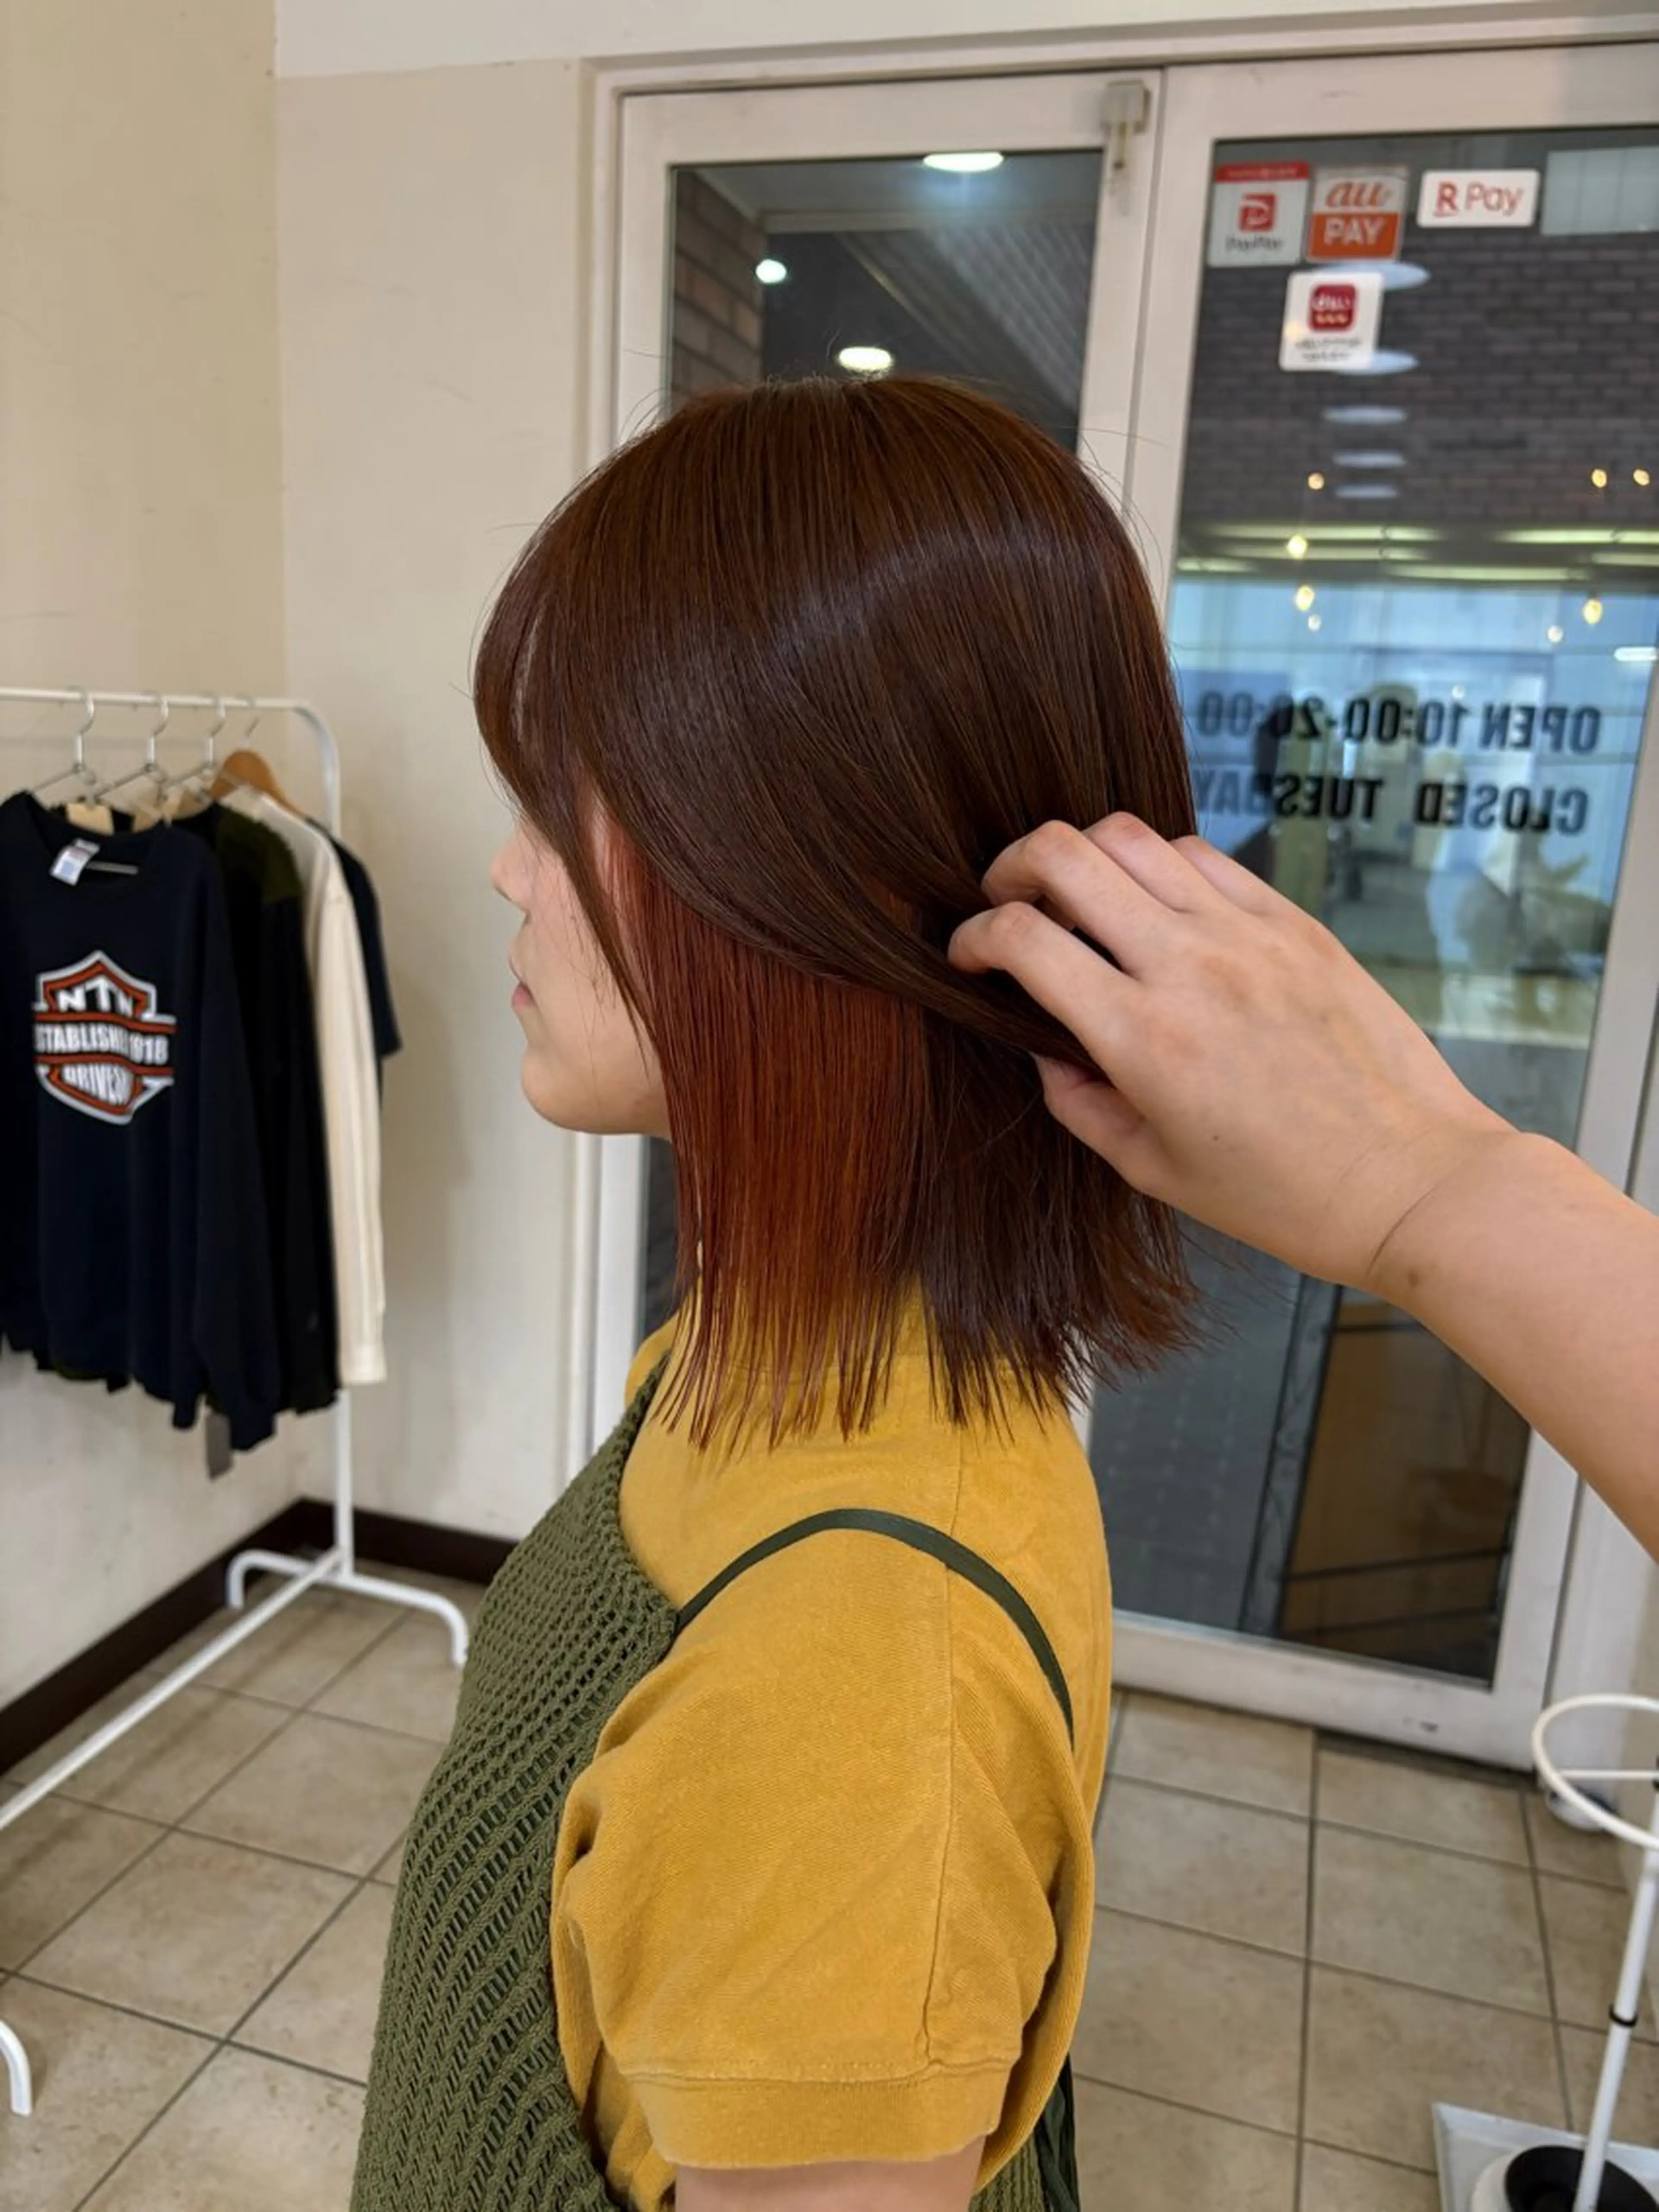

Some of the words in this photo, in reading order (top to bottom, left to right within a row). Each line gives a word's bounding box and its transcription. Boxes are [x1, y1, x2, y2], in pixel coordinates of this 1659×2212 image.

[1325, 180, 1388, 207] au
[1466, 182, 1525, 216] Pay
[1324, 217, 1386, 245] PAY
